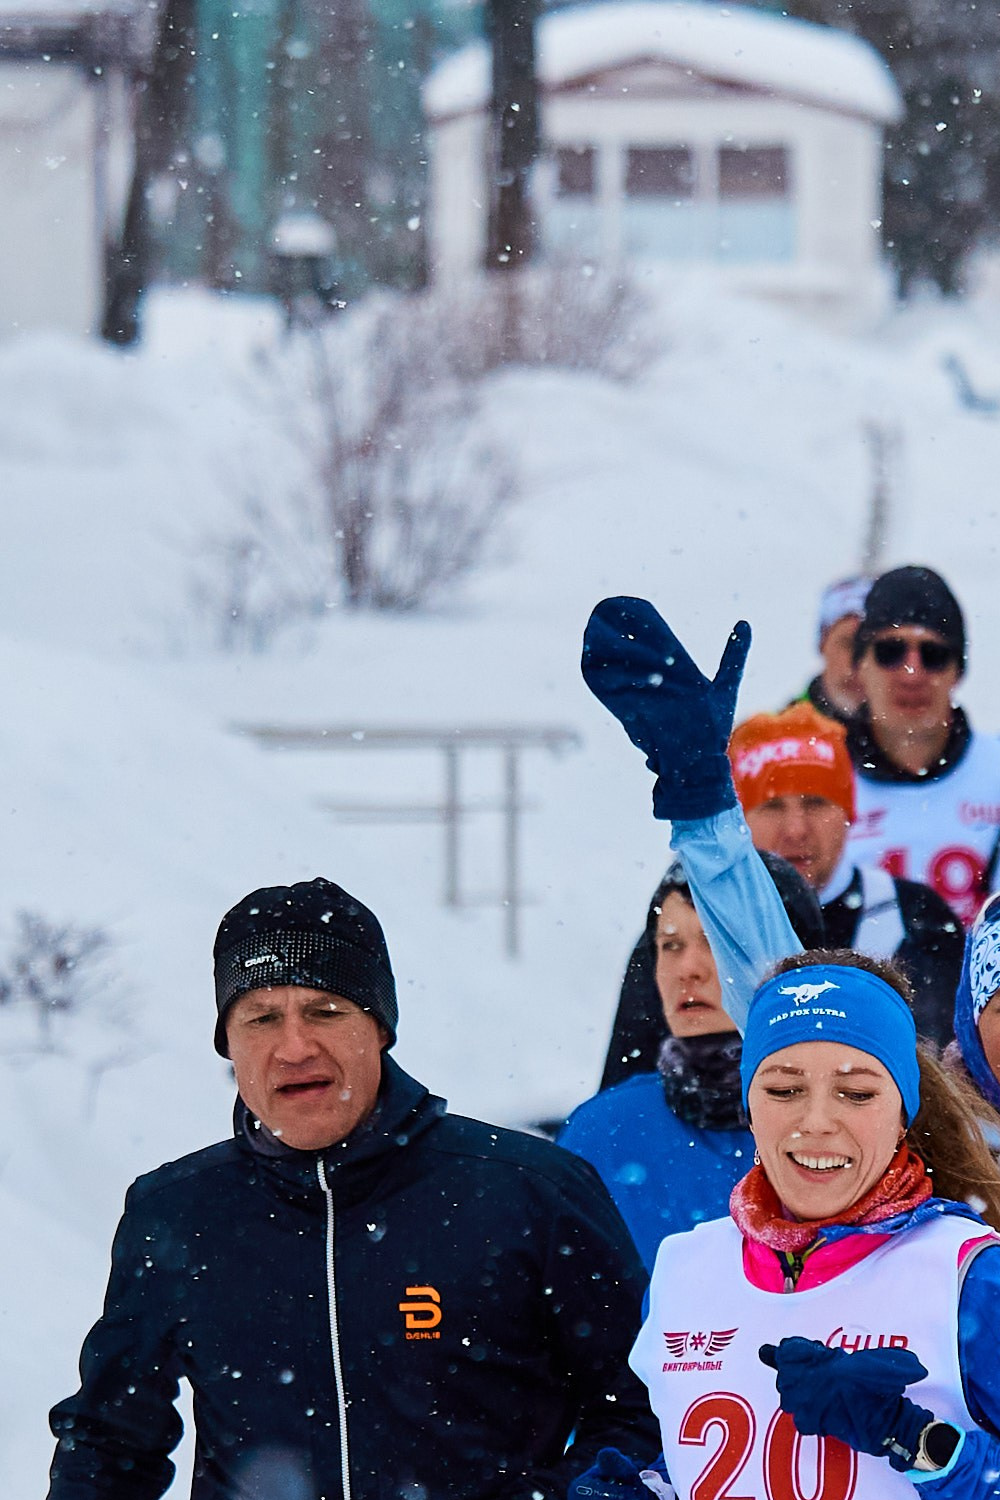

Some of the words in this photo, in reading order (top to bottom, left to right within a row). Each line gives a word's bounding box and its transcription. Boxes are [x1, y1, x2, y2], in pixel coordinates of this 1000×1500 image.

[769, 1013, 789, 1026] MAD
[790, 1008, 810, 1017] FOX
[812, 1008, 847, 1018] ULTRA
[662, 1361, 723, 1373] ВИНТОКРЫЛЫЕ
